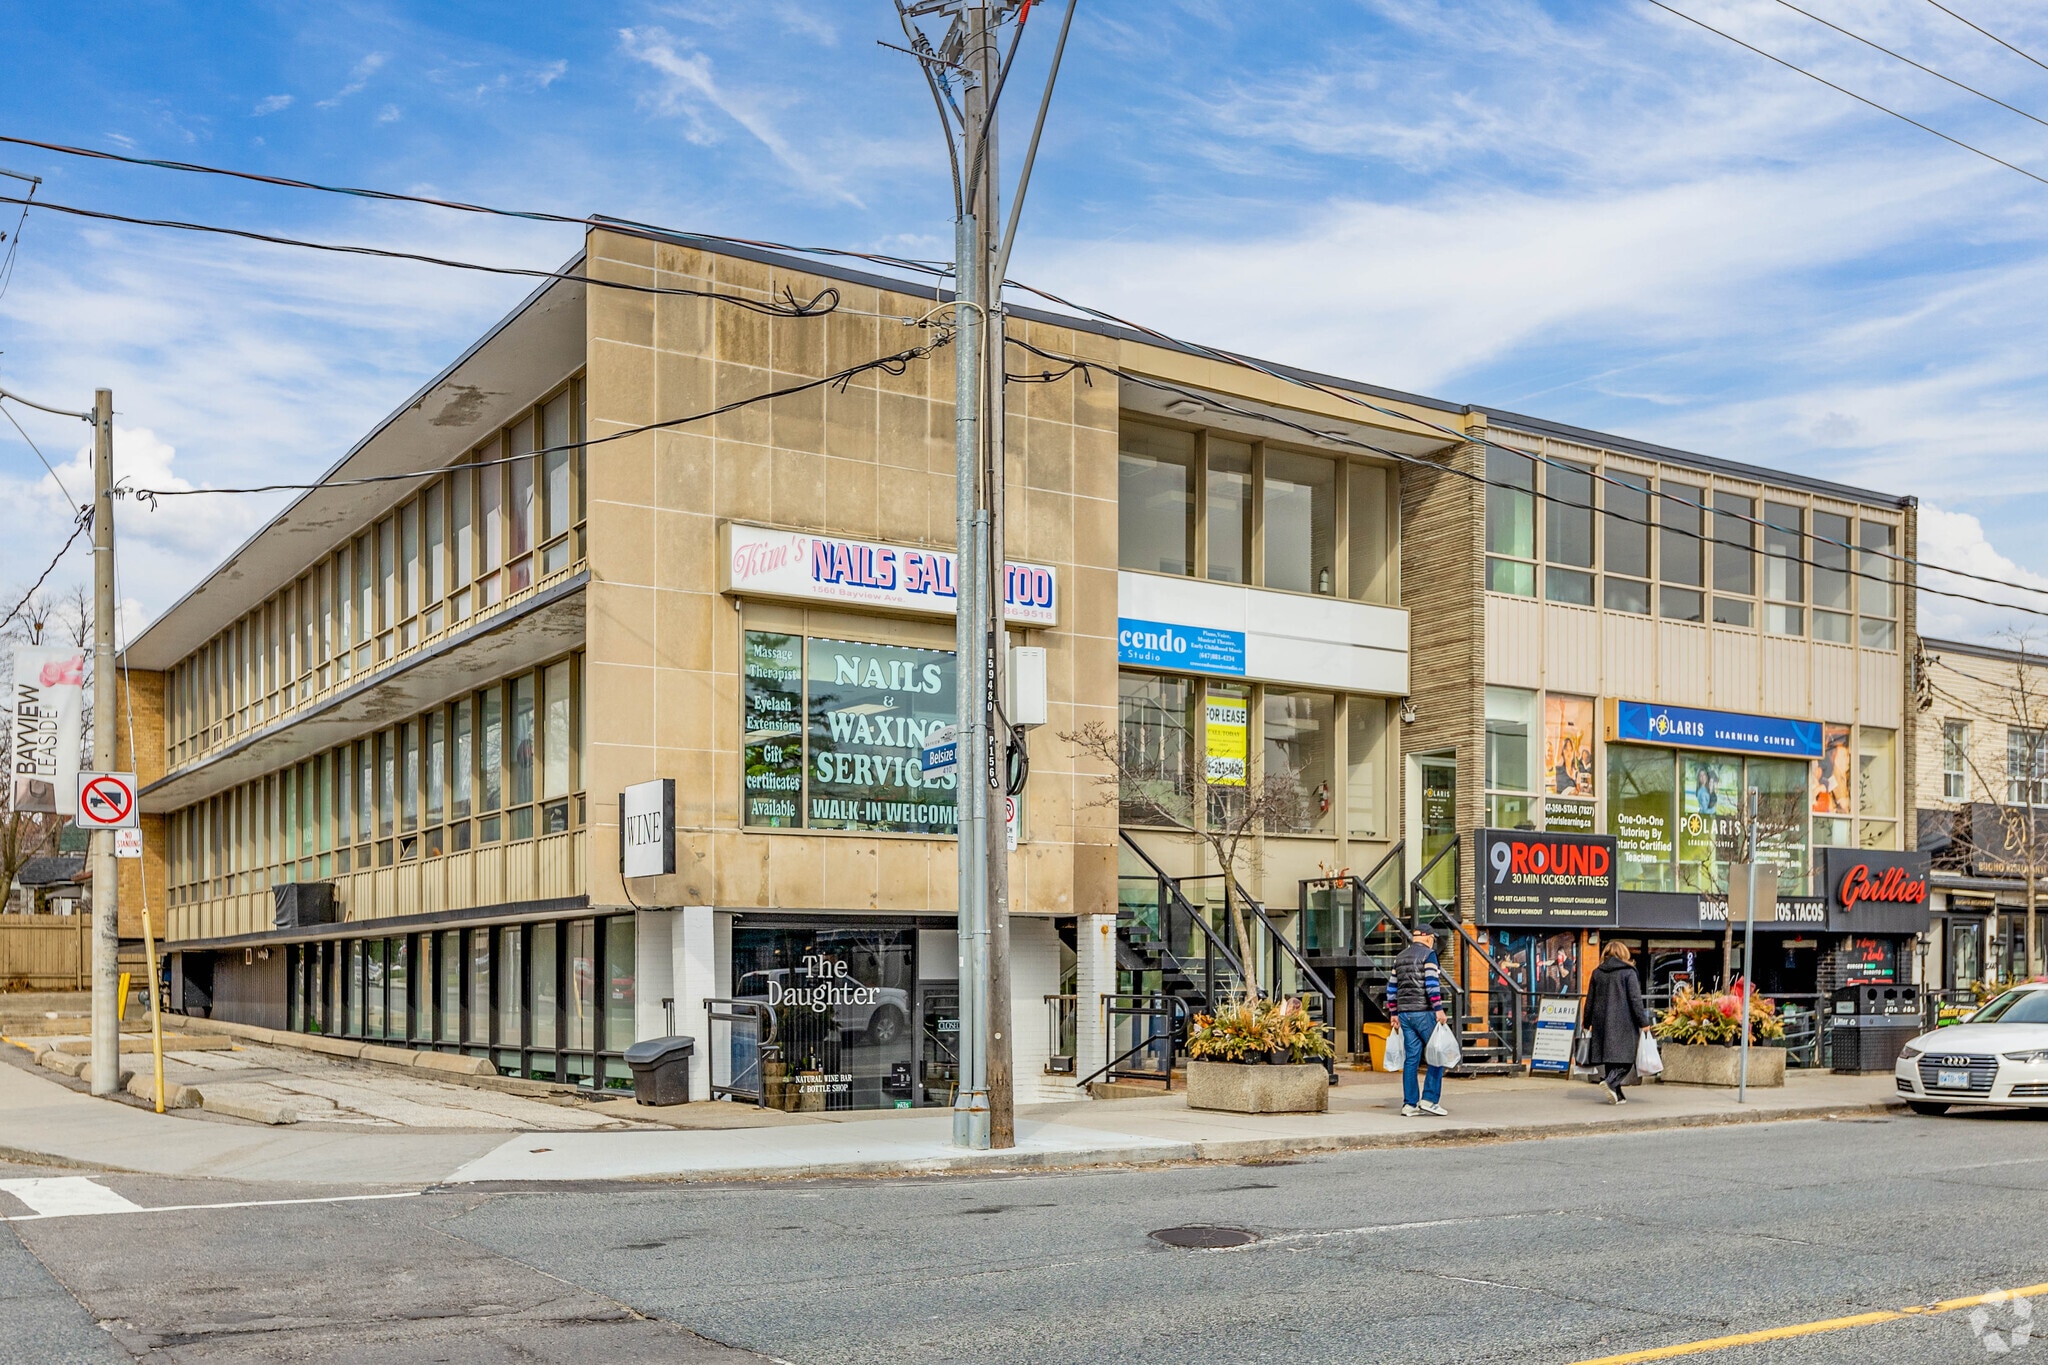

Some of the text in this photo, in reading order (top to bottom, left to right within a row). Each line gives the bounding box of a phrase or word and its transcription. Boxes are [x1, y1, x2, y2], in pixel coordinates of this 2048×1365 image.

[733, 535, 806, 581] Kim's
[812, 540, 1053, 608] NAILS SAL TOO
[812, 585, 906, 603] 1560 Bayview Ave.
[754, 644, 793, 662] Massage
[1128, 650, 1160, 661] Studio
[749, 664, 797, 682] Therapist
[833, 654, 942, 694] NAILS
[754, 695, 792, 713] Eyelash
[883, 695, 894, 708] &
[746, 716, 801, 732] Extensions
[1221, 710, 1246, 724] LEASE
[16, 684, 39, 774] BAYVIEW
[1649, 713, 1795, 747] POLARIS LEARNING CENTRE
[37, 710, 58, 776] LEASIDE
[763, 744, 783, 762] Gift
[930, 747, 953, 765] Belsize
[988, 735, 999, 788] P1560
[746, 771, 800, 791] certificates
[751, 798, 796, 817] Available
[812, 799, 882, 821] WALK-IN
[1618, 813, 1664, 826] One-On-One
[1680, 814, 1741, 836] POLARIS
[626, 811, 661, 847] WINE
[1620, 826, 1662, 840] Tutoring By
[1640, 840, 1672, 851] Certified
[1625, 851, 1657, 863] Teachers
[1512, 873, 1609, 887] 30 MIN KICKBOX FITNESS
[1700, 901, 1729, 920] BURG
[802, 955, 848, 978] The
[767, 980, 880, 1013] Daughter
[1542, 1005, 1575, 1014] POLARIS
[1834, 1017, 1848, 1026] Litter
[795, 1073, 853, 1084] NATURAL WINE BAR
[806, 1084, 831, 1093] BOTTLE
[831, 1084, 849, 1092] SHOP
